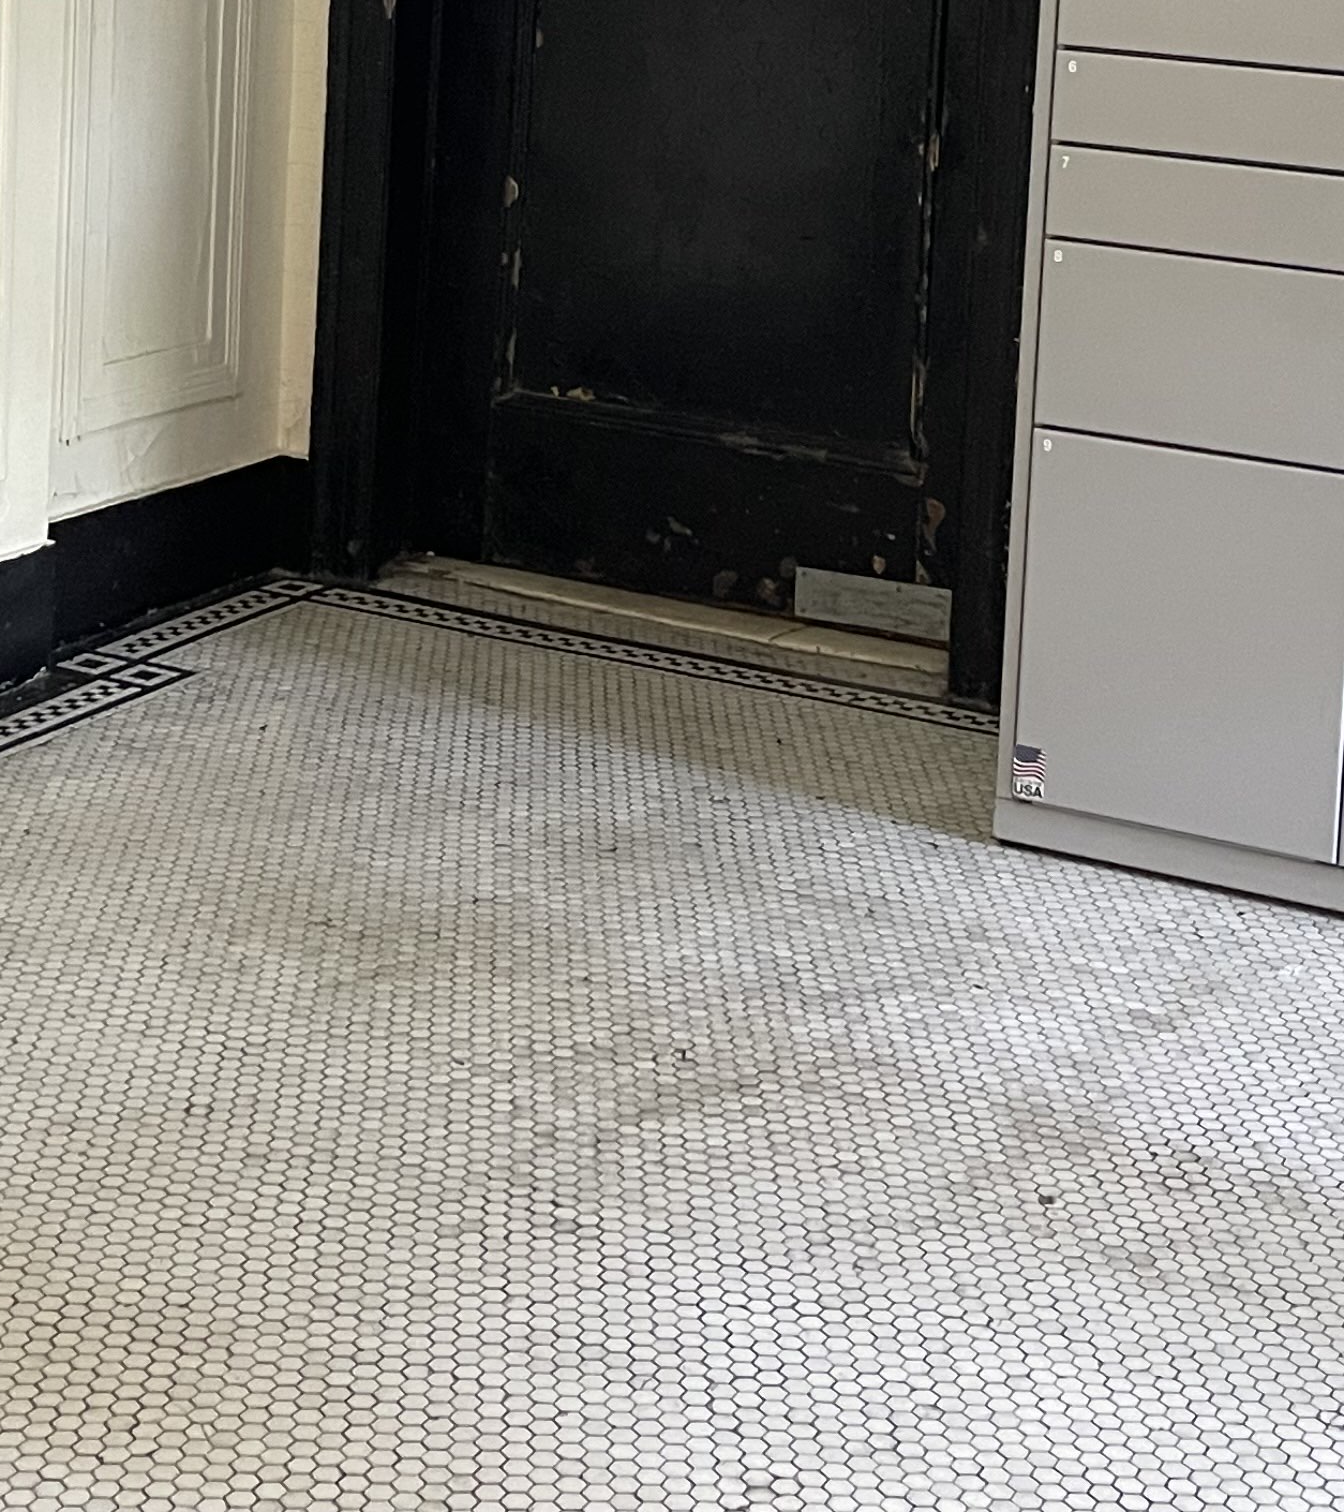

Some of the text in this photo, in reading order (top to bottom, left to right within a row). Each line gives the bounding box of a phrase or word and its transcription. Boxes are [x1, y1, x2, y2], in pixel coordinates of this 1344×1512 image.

[1068, 60, 1077, 73] 6
[1061, 155, 1070, 169] 7
[1053, 249, 1063, 263] 8
[1043, 438, 1053, 452] 9
[1015, 782, 1043, 798] USA
